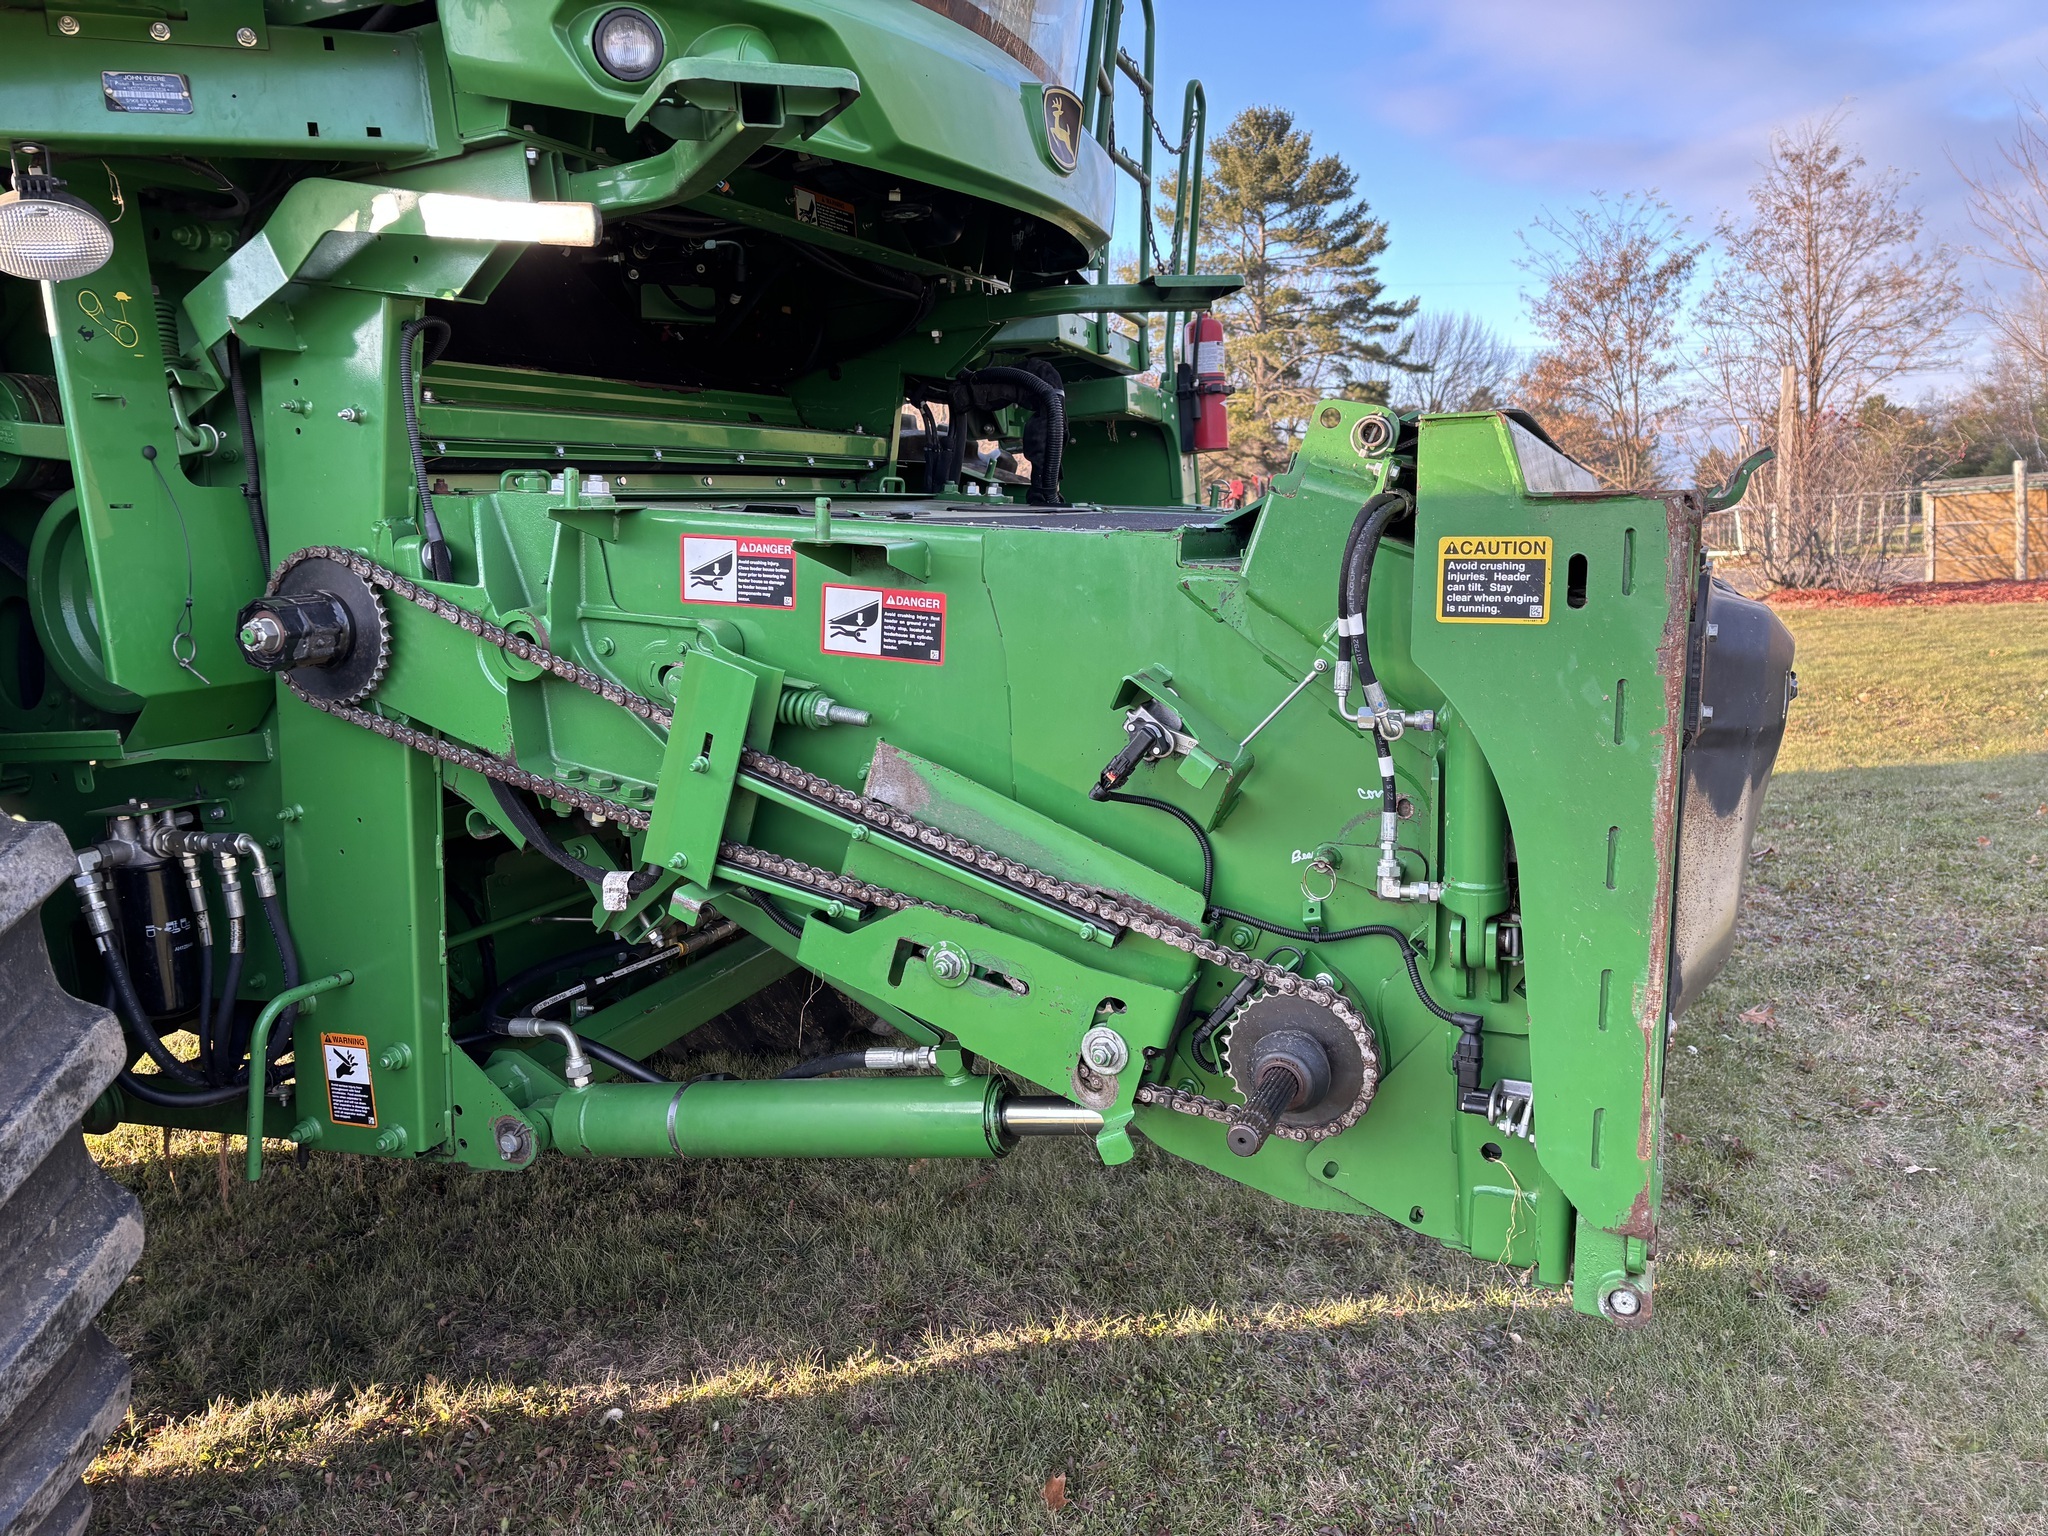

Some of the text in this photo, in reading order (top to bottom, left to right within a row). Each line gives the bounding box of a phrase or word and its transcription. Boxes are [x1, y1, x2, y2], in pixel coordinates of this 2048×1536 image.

[749, 543, 791, 554] DANGER
[1460, 541, 1546, 555] CAUTION
[1448, 561, 1526, 572] Avoid crushing
[1447, 572, 1531, 582] injuries. Header
[1447, 583, 1513, 593] can tilt. Stay
[896, 596, 940, 609] DANGER
[1446, 593, 1540, 605] clear when engine
[1446, 604, 1501, 615] is running.
[1386, 784, 1394, 801] 22.5
[332, 1036, 365, 1046] WARNING
